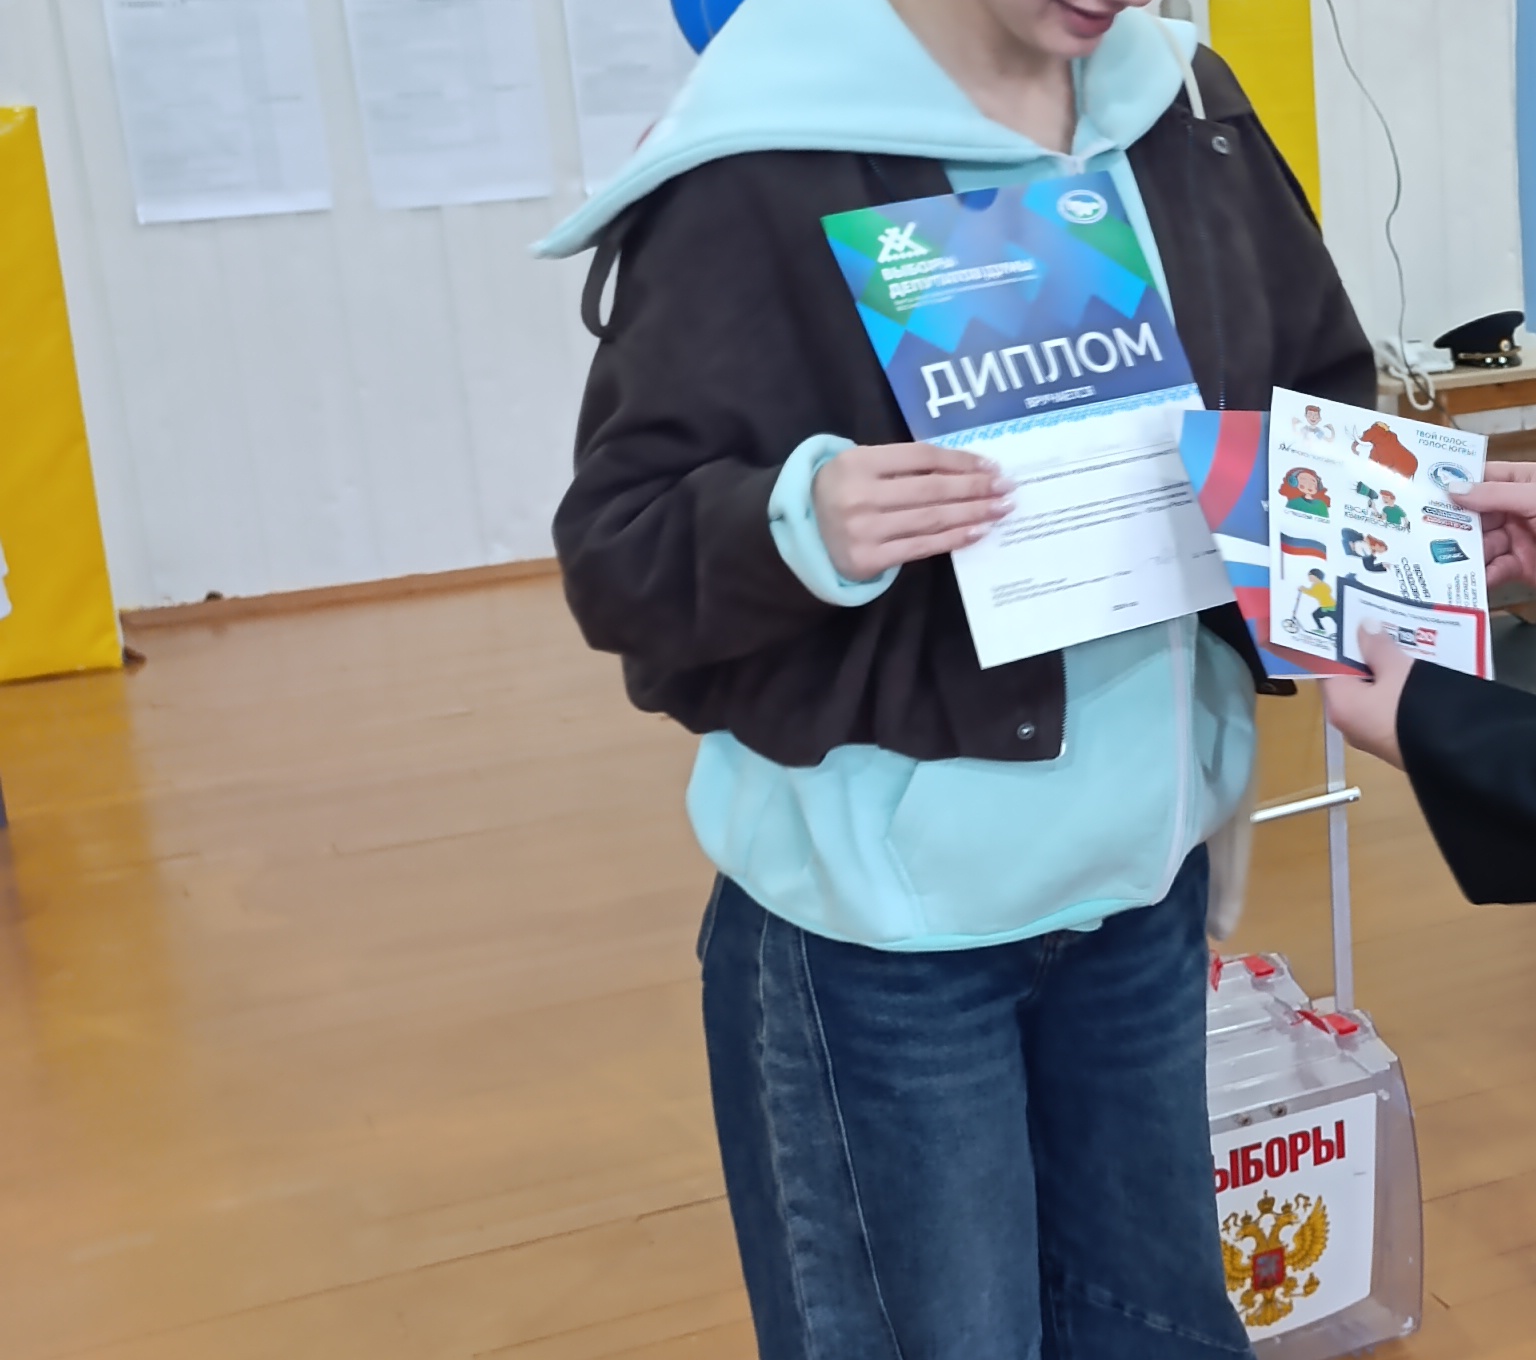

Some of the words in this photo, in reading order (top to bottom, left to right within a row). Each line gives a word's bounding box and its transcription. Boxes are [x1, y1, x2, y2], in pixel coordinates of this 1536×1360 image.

[920, 322, 1163, 419] ДИПЛОМ
[1418, 438, 1447, 449] ГОЛОС
[1439, 435, 1468, 447] ГОЛОС
[1211, 1120, 1346, 1194] ЫБОРЫ
